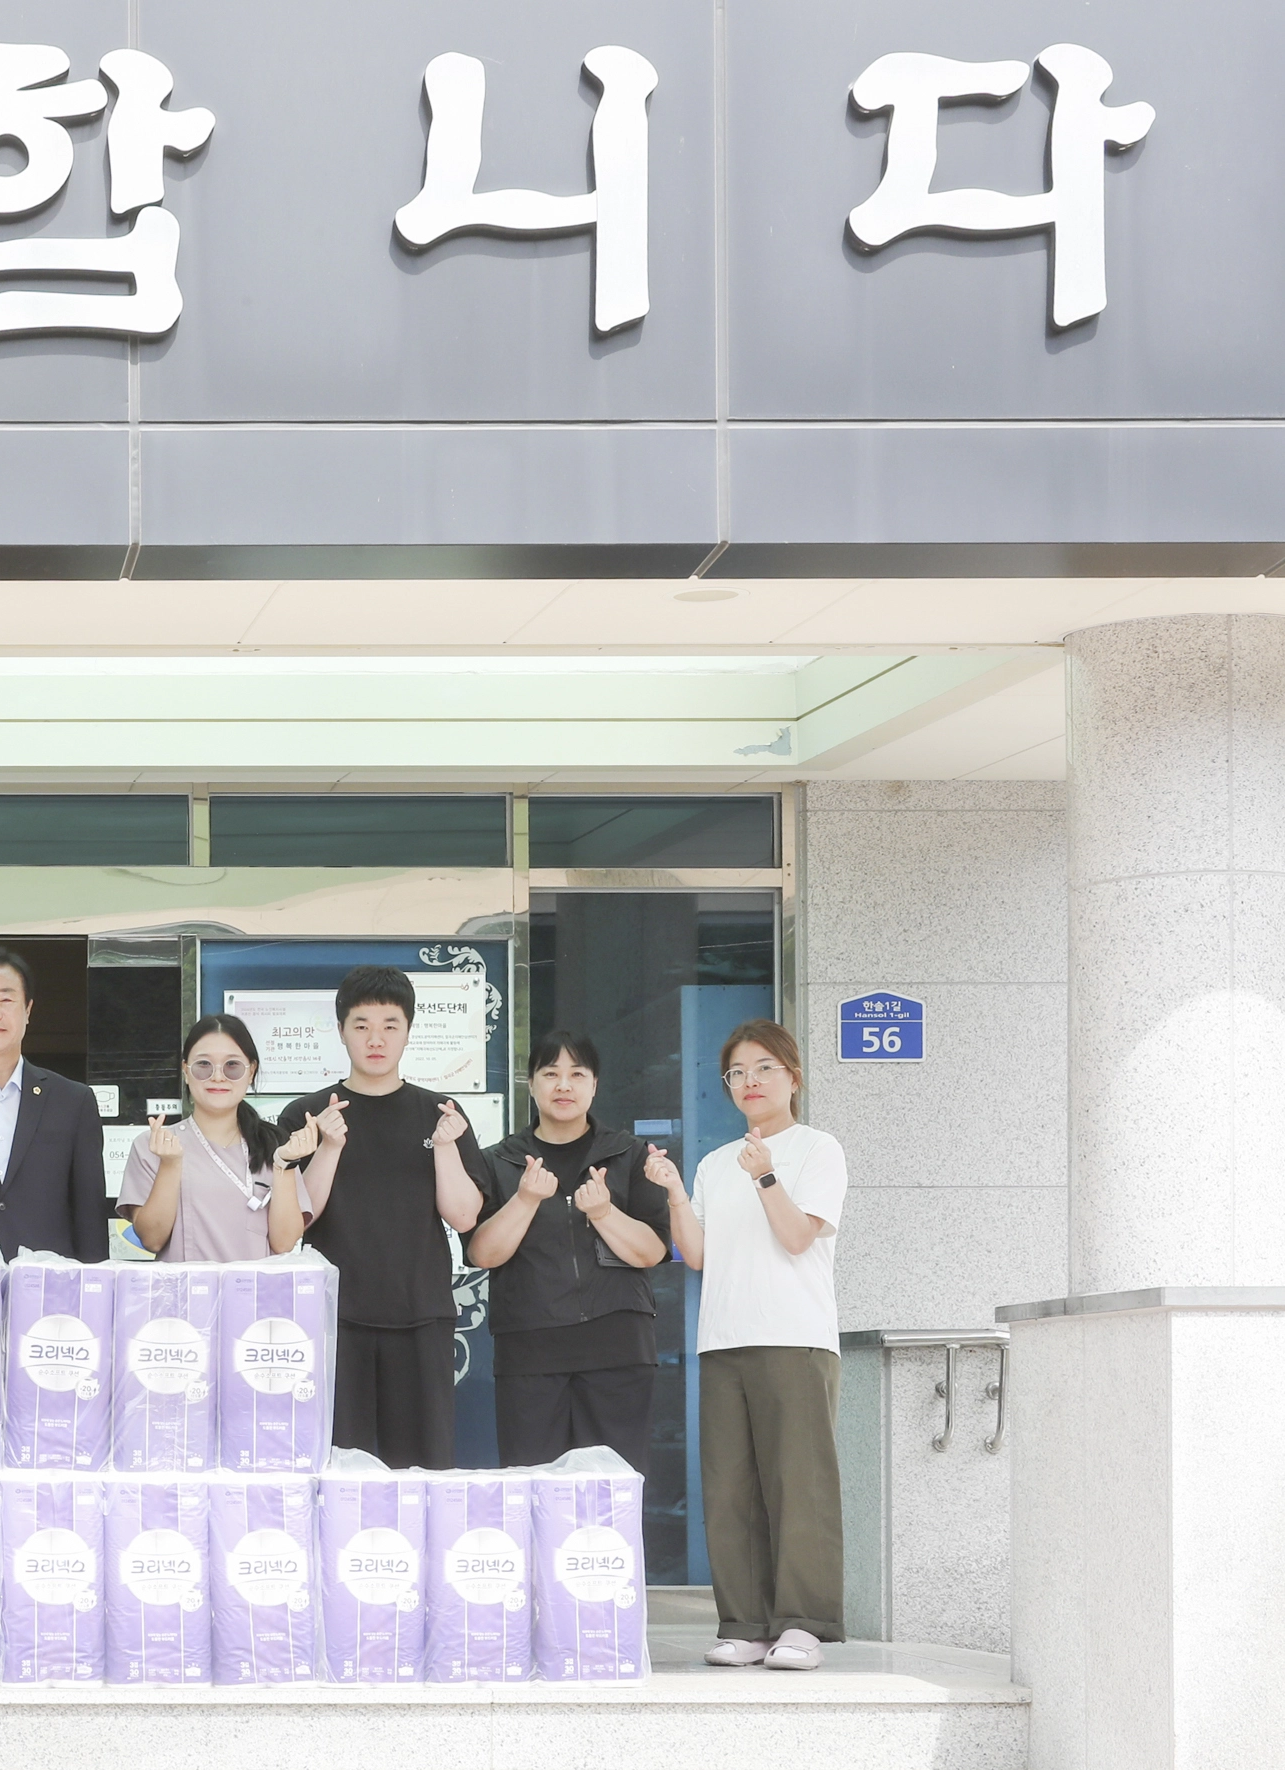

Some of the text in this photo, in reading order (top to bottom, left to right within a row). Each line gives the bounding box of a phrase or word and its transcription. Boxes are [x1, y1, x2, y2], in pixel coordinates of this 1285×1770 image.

[416, 1003, 468, 1014] 복선도단체
[863, 1001, 901, 1011] 한솔1길
[272, 1026, 314, 1038] 최고의 맛
[862, 1027, 902, 1052] 56
[28, 1344, 90, 1362] 크리넥스
[137, 1348, 199, 1364] 크리넥스
[244, 1348, 306, 1364] 크리넥스
[25, 1558, 85, 1576] 크리넥스
[130, 1558, 191, 1576] 크리넥스
[238, 1560, 298, 1576] 크리넥스
[348, 1558, 409, 1574] 크리넥스
[455, 1558, 515, 1574] 크리넥스
[565, 1556, 625, 1572] 크리넥스
